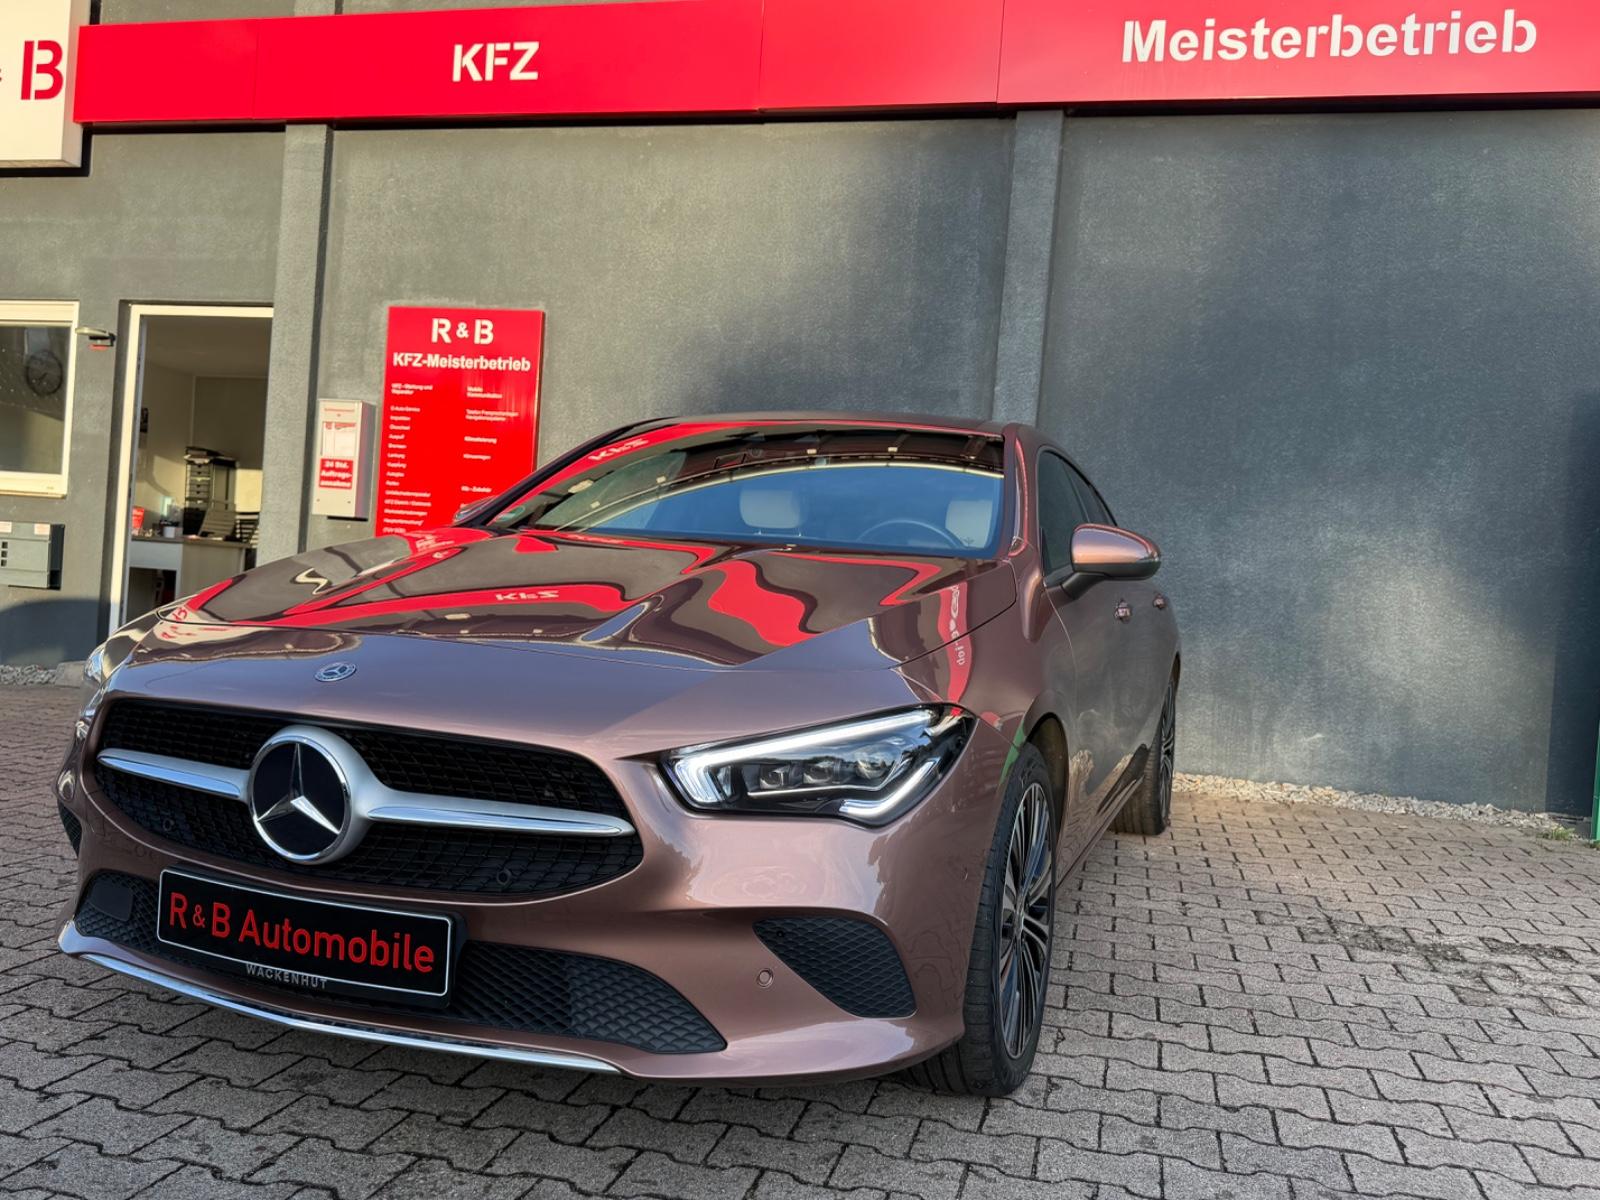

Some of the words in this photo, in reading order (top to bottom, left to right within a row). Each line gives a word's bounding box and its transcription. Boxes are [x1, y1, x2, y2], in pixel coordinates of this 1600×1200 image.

[1121, 9, 1537, 63] Meisterbetrieb
[21, 40, 64, 101] B
[451, 41, 540, 82] KFZ
[431, 318, 452, 344] R
[456, 322, 470, 339] &
[473, 319, 494, 345] B
[393, 352, 531, 372] KFZ-Meisterbetrieb
[169, 892, 188, 929] R
[192, 904, 206, 928] &
[211, 902, 231, 938] B
[238, 909, 435, 973] Automobile
[246, 963, 328, 989] WACKENHUT
